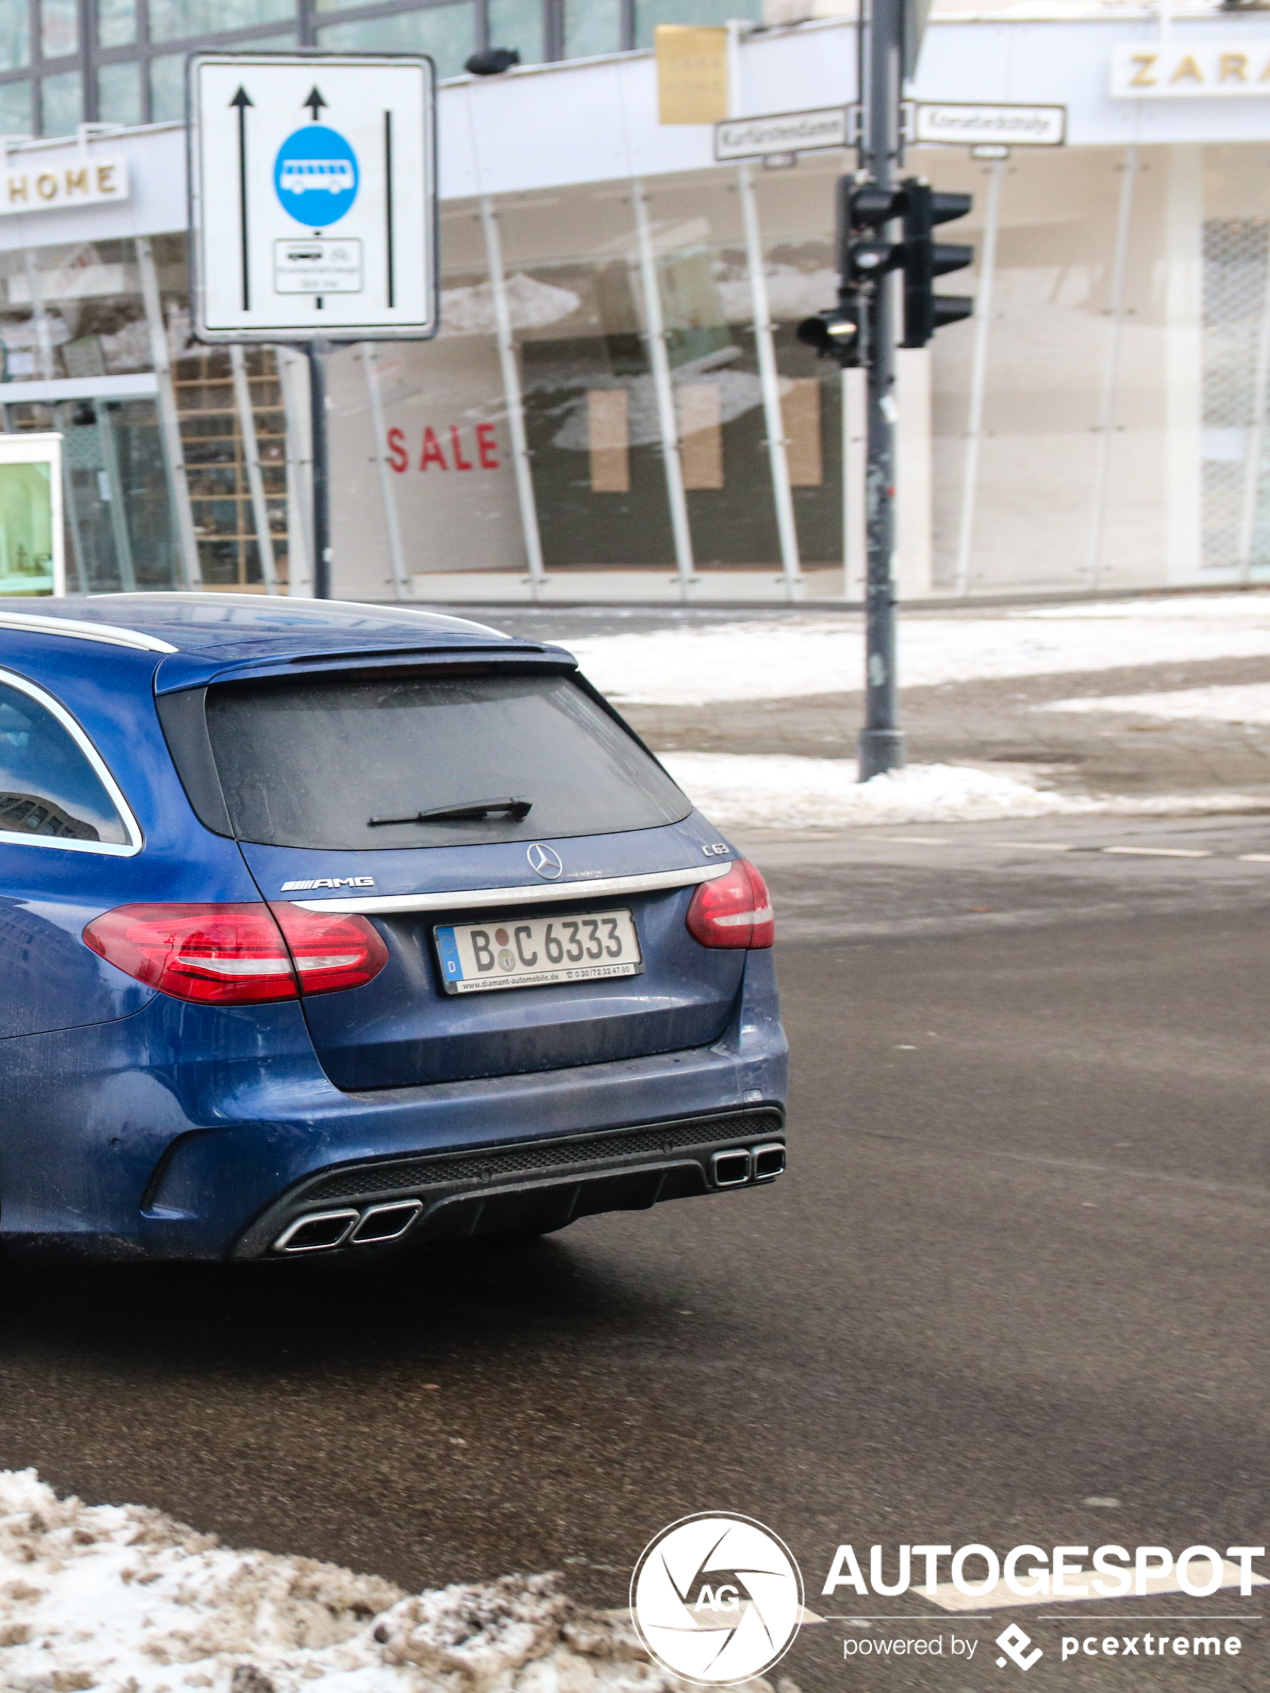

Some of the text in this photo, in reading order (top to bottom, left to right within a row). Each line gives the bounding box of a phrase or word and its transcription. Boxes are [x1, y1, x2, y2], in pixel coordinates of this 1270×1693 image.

[8, 165, 116, 203] HOME
[387, 422, 500, 474] SALE
[702, 843, 729, 857] C 63
[311, 876, 375, 890] AMG
[470, 917, 622, 972] B C 6333
[448, 961, 456, 973] D
[462, 973, 559, 990] www.diamant-automobile.de
